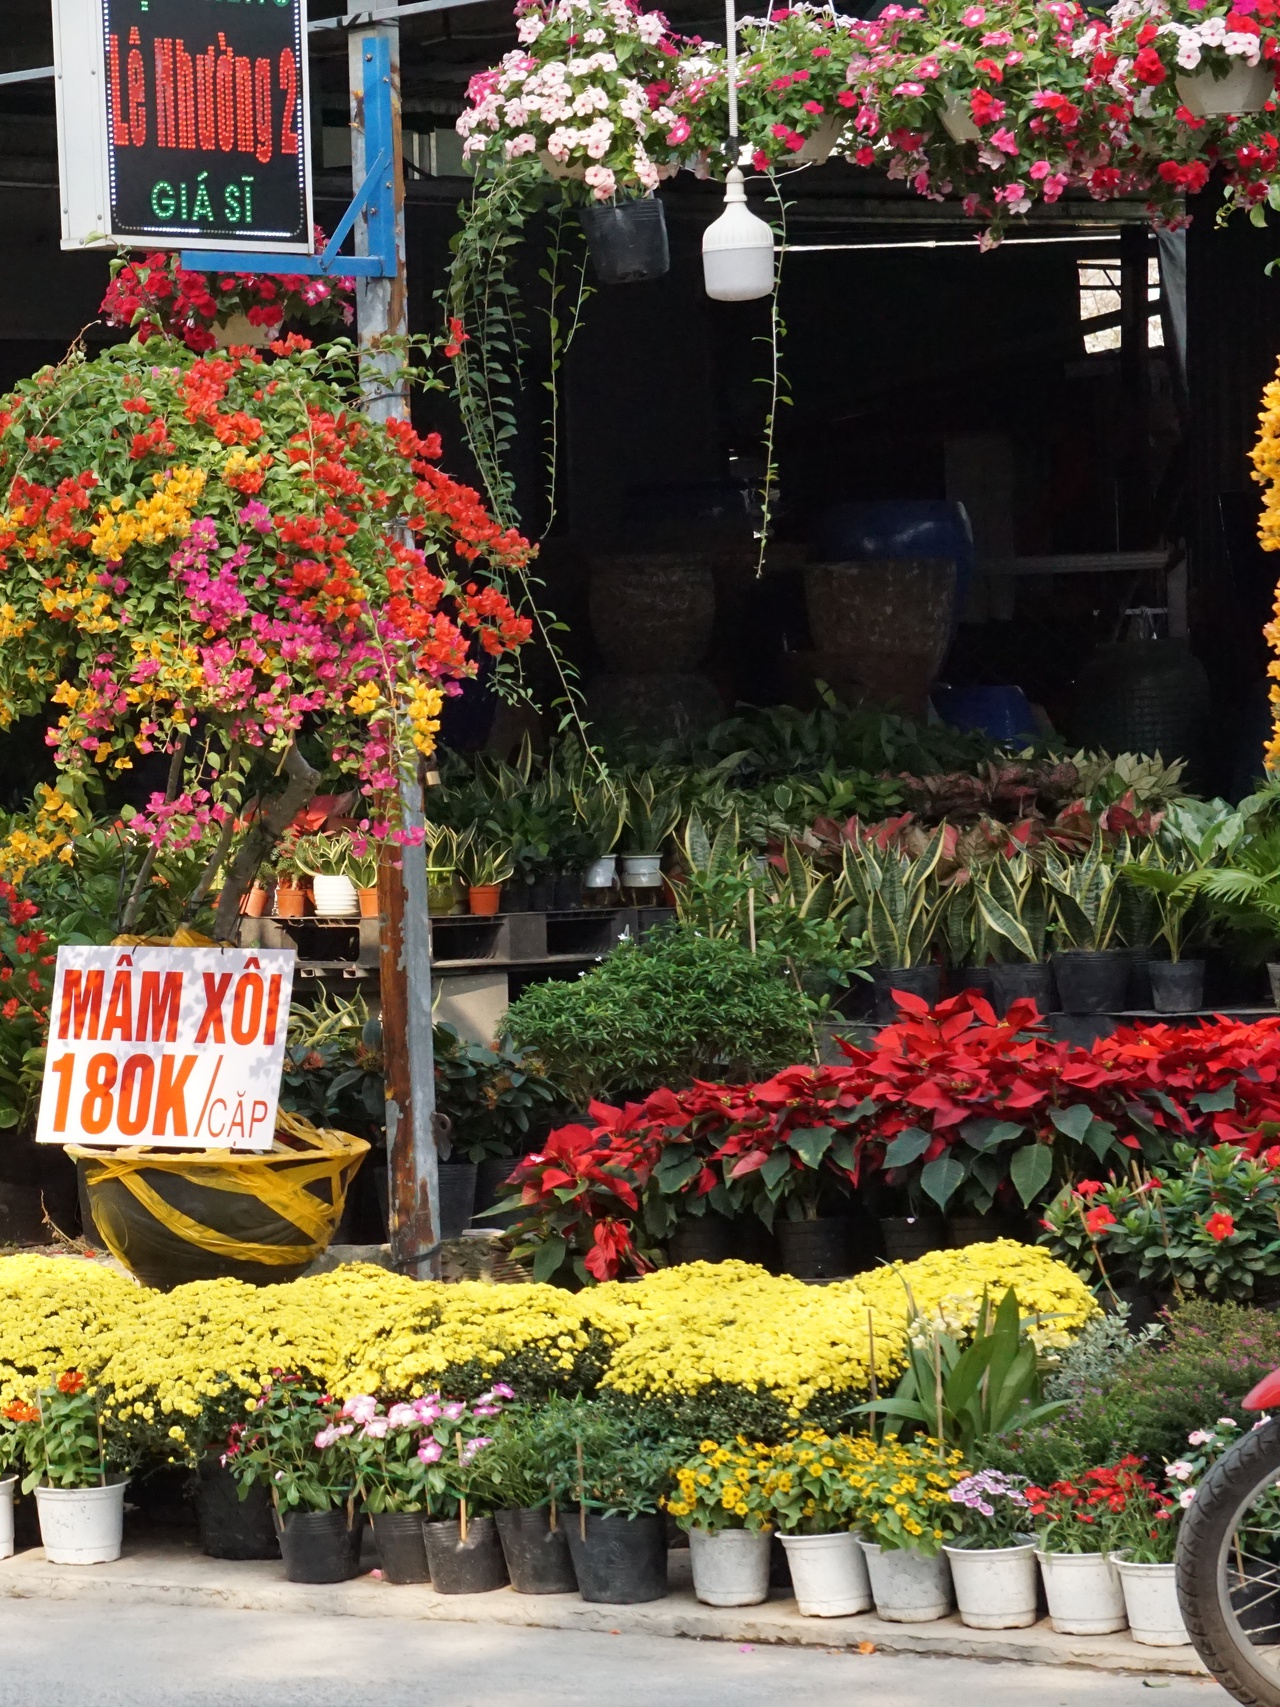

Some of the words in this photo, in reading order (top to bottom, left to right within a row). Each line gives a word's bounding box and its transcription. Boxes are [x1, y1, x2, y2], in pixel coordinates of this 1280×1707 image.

[110, 26, 147, 147] Lê
[154, 32, 273, 164] Nhường
[279, 47, 299, 154] 2
[151, 171, 215, 222] GIÁ
[224, 176, 255, 223] SĨ
[57, 954, 184, 1042] MÂM
[194, 957, 283, 1046] XÔI
